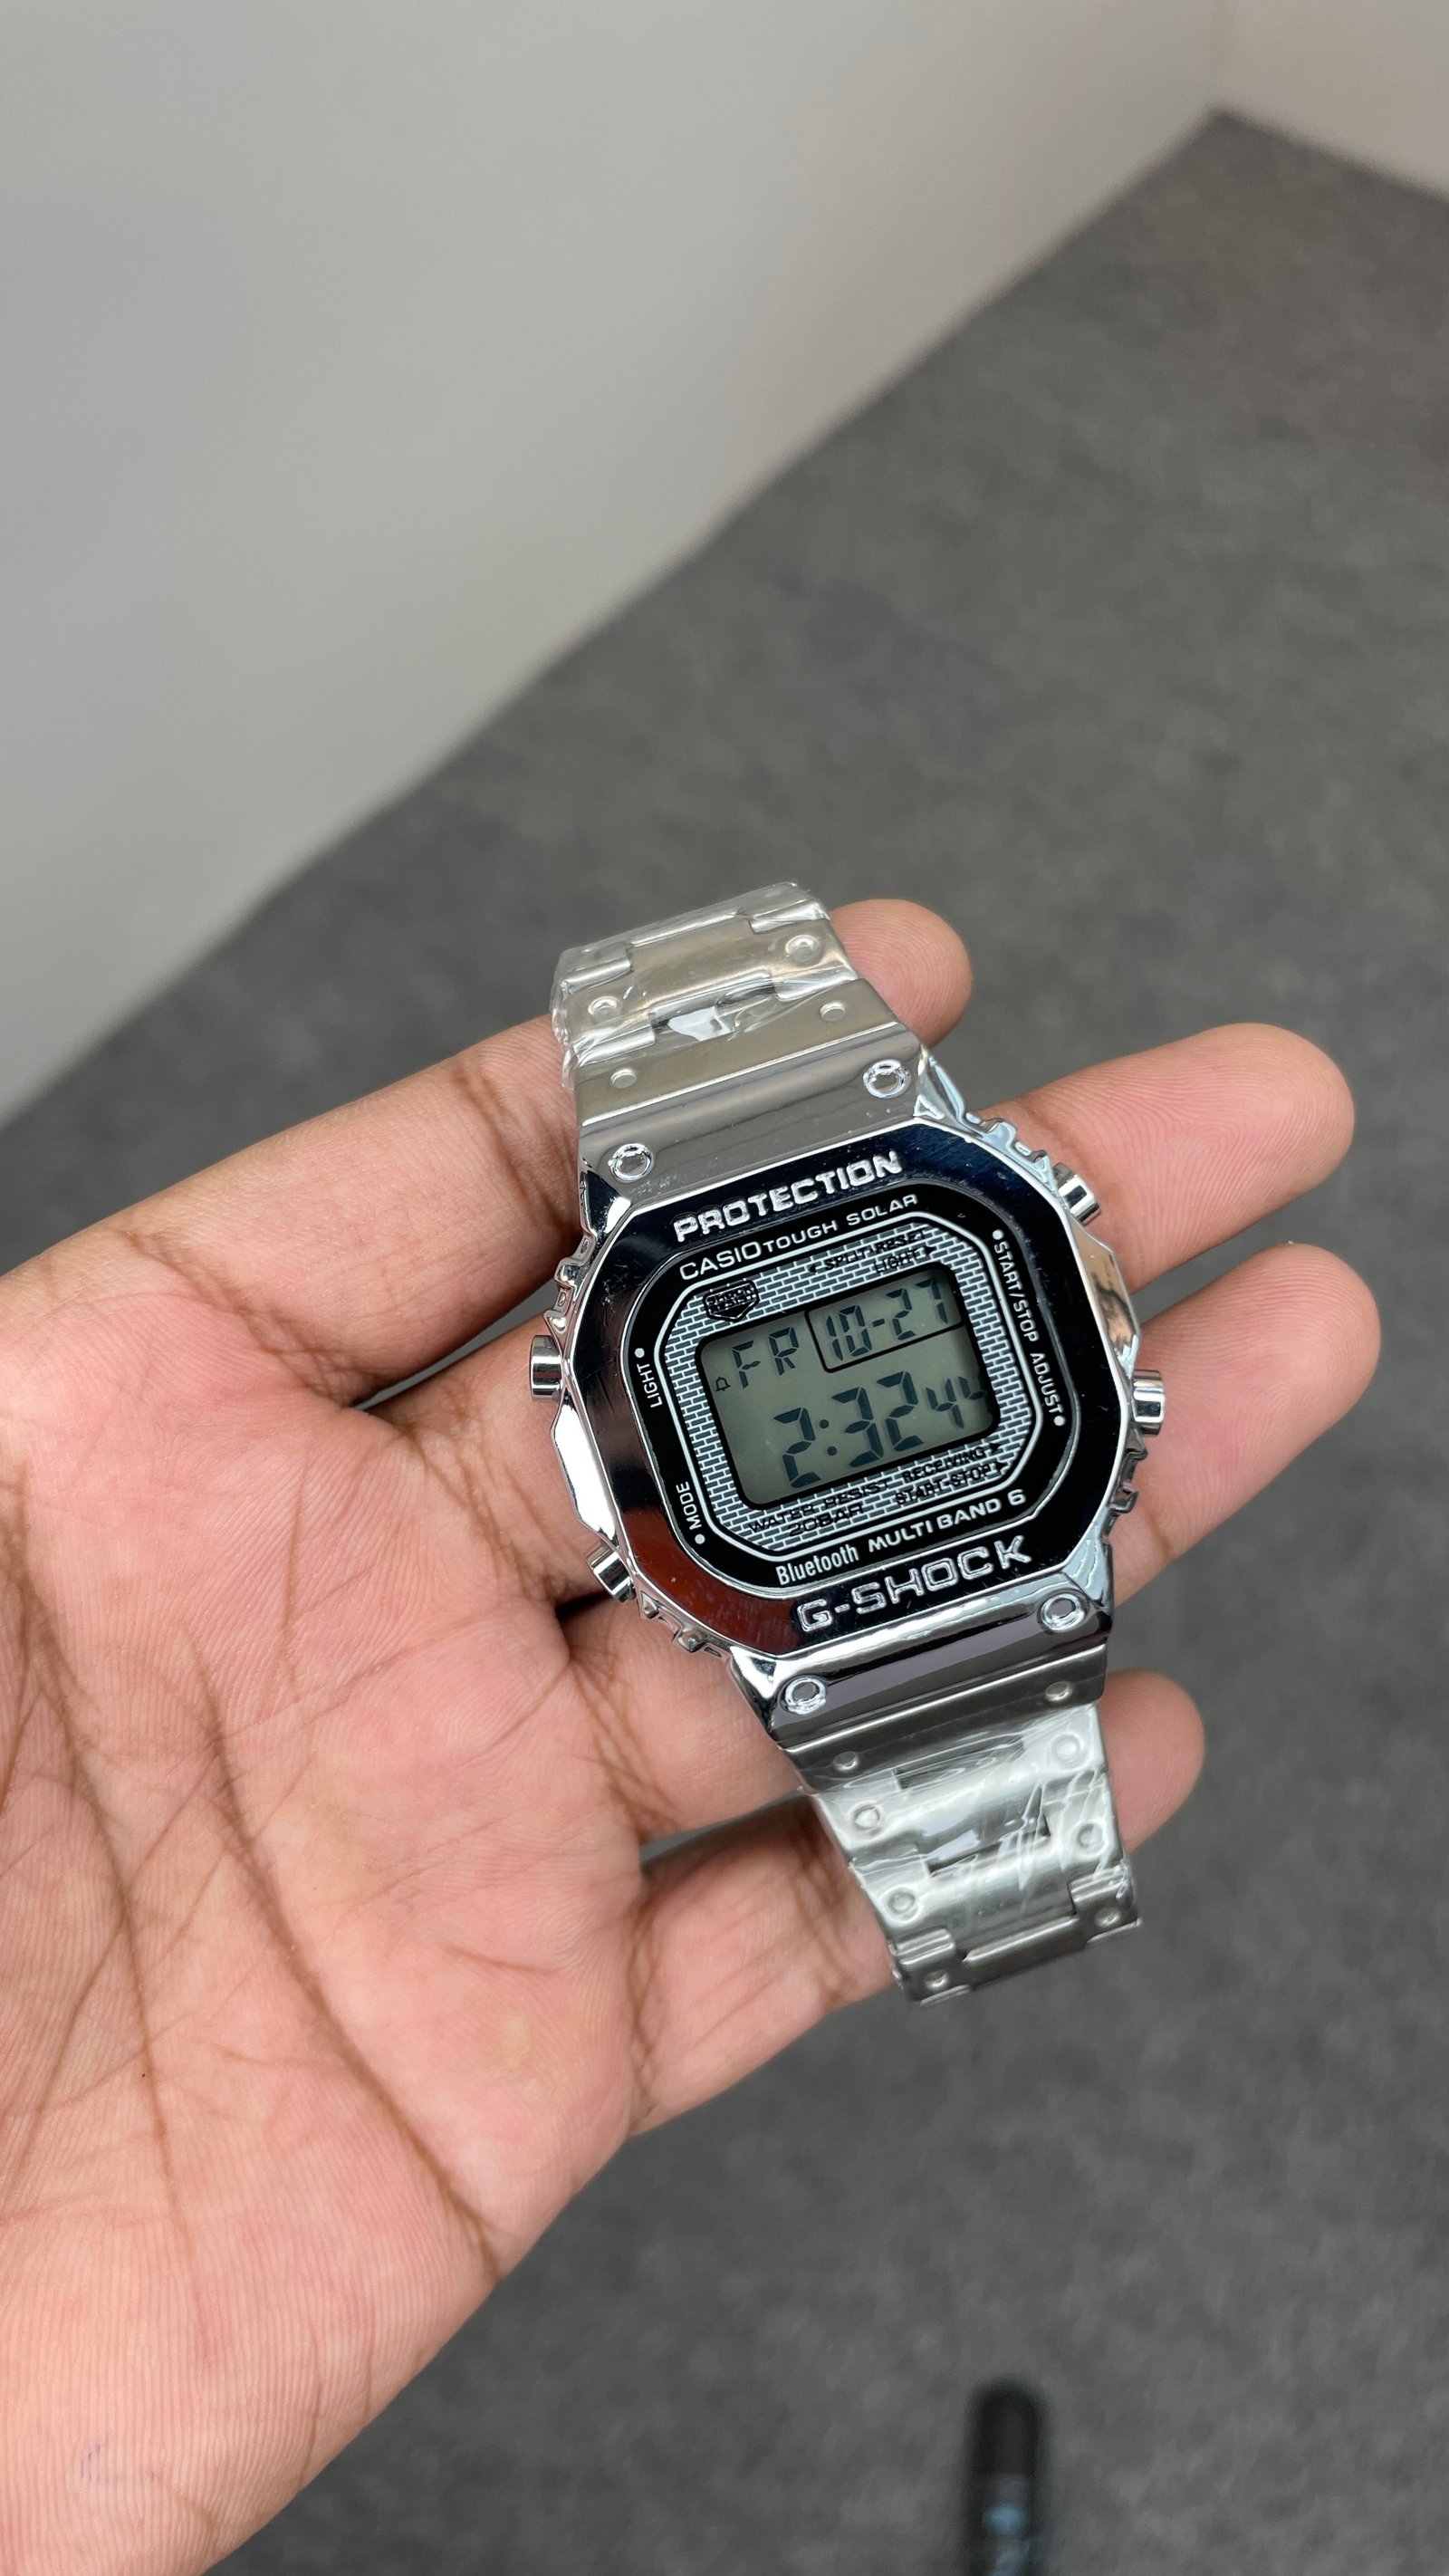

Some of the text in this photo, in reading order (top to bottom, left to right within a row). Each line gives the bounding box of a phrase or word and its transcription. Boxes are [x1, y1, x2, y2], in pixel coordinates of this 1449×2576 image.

[674, 1149, 903, 1242] PROTECTION
[679, 1194, 918, 1281] CASIO TOUGH SOLAR
[874, 1249, 918, 1274] LIGHT
[826, 1277, 948, 1361] 10-27
[993, 1240, 1064, 1413] START/STOP ADJUST
[637, 1363, 663, 1408] LIGHT
[732, 1326, 799, 1389] FR
[902, 1447, 985, 1483] RECEIVING
[676, 1481, 702, 1530] MODE
[747, 1479, 890, 1533] WATER RESIST
[788, 1504, 865, 1538] 20BAR
[775, 1489, 1026, 1586] Bluetooth MULTI BAND 6
[796, 1534, 1032, 1632] G-SHOCK
